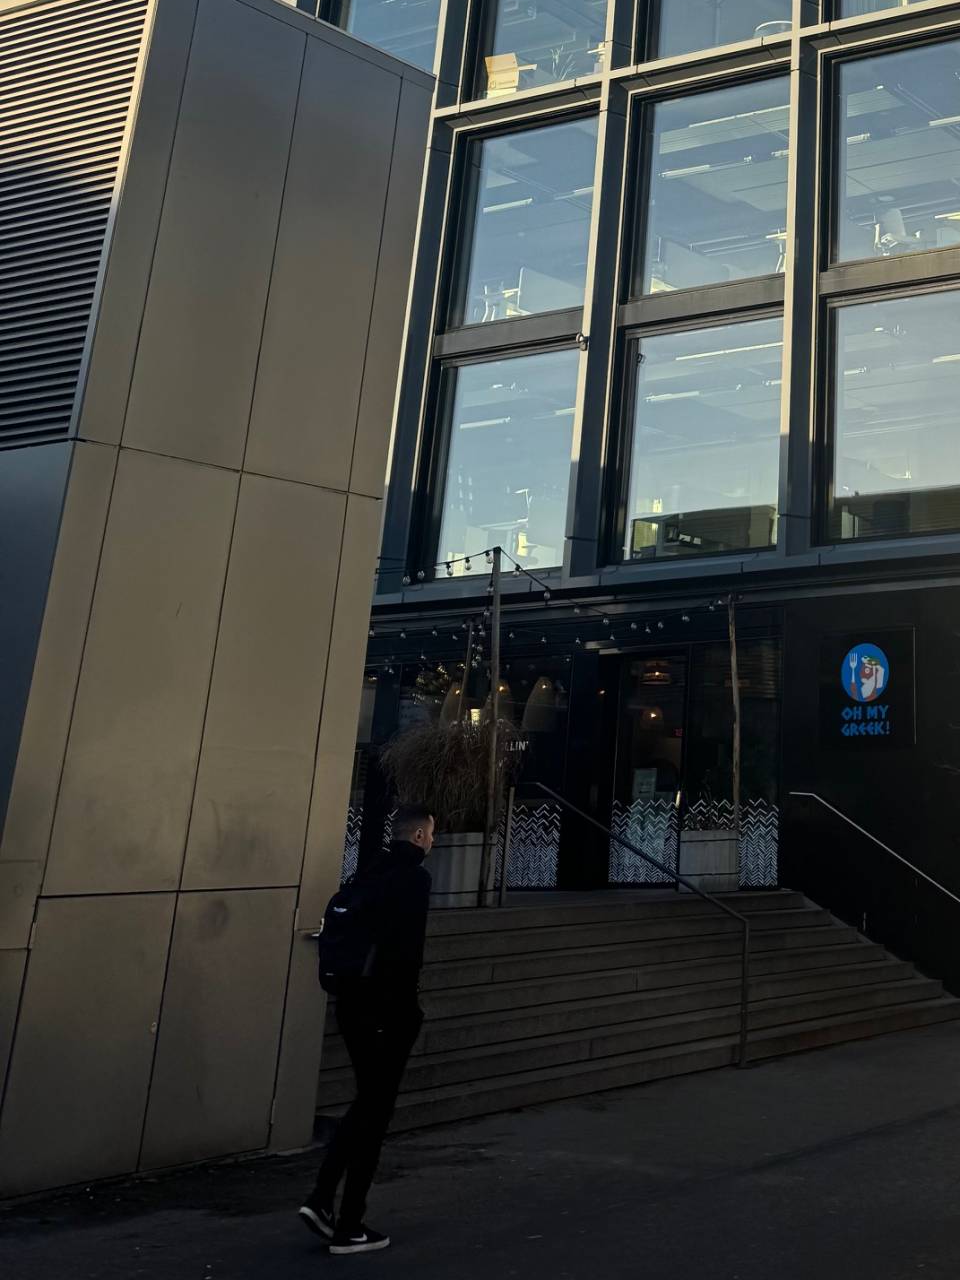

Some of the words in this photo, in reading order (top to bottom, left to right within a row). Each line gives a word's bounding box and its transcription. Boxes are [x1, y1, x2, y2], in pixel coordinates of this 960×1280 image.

[840, 706, 862, 721] OH
[867, 705, 889, 720] MY
[841, 721, 890, 737] GREEK!
